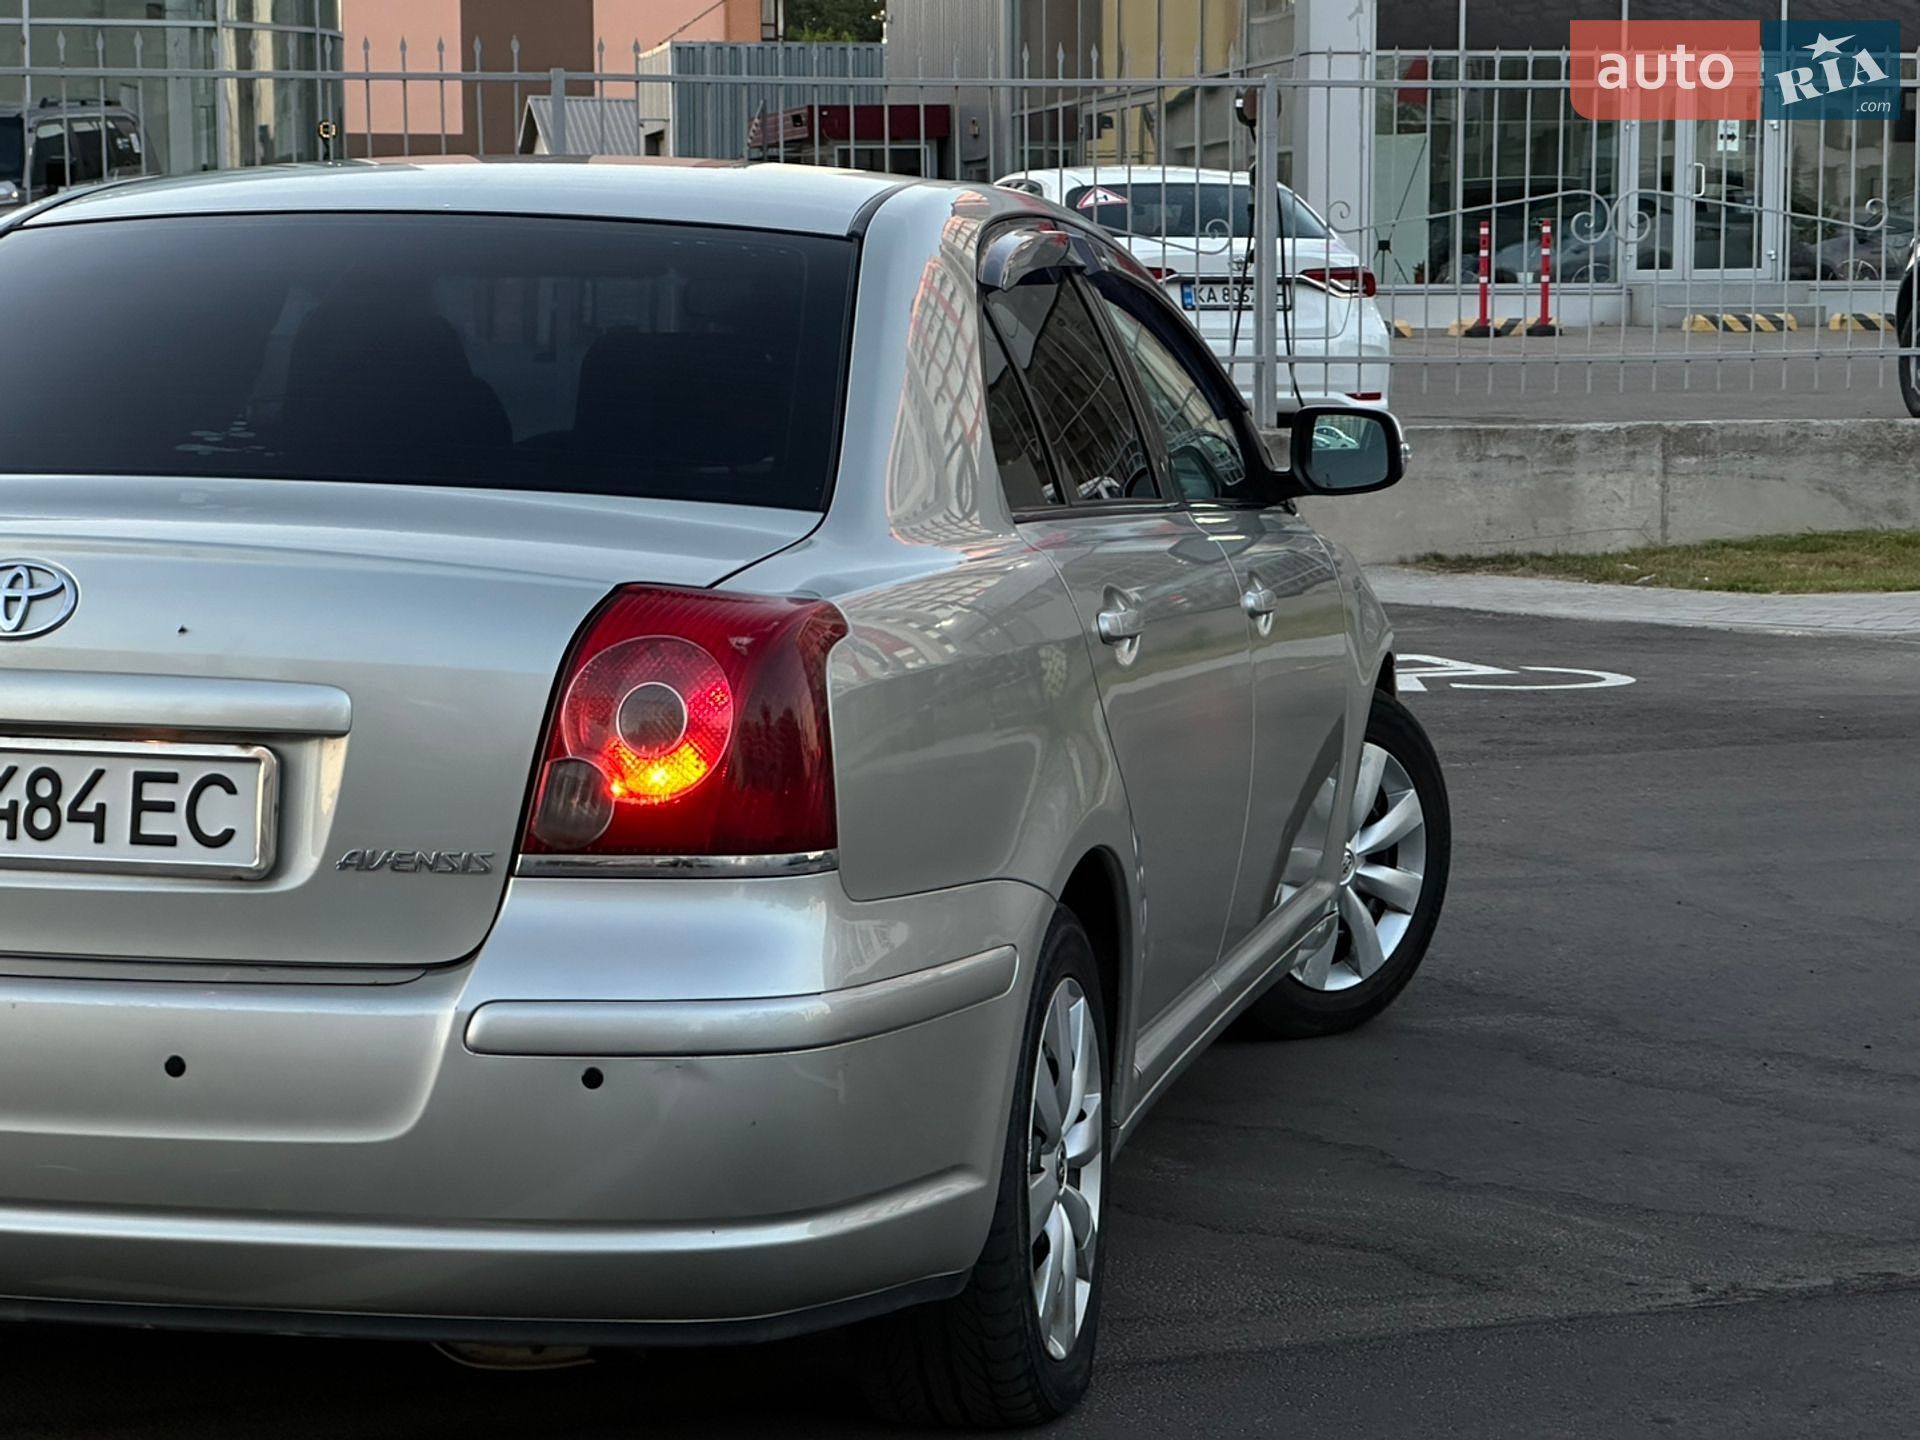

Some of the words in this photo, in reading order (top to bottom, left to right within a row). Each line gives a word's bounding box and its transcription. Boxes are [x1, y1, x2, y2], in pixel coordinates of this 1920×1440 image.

[1193, 287, 1217, 303] KA
[1222, 287, 1256, 303] 806
[129, 771, 238, 848] EC
[335, 849, 495, 873] AVENSIS
